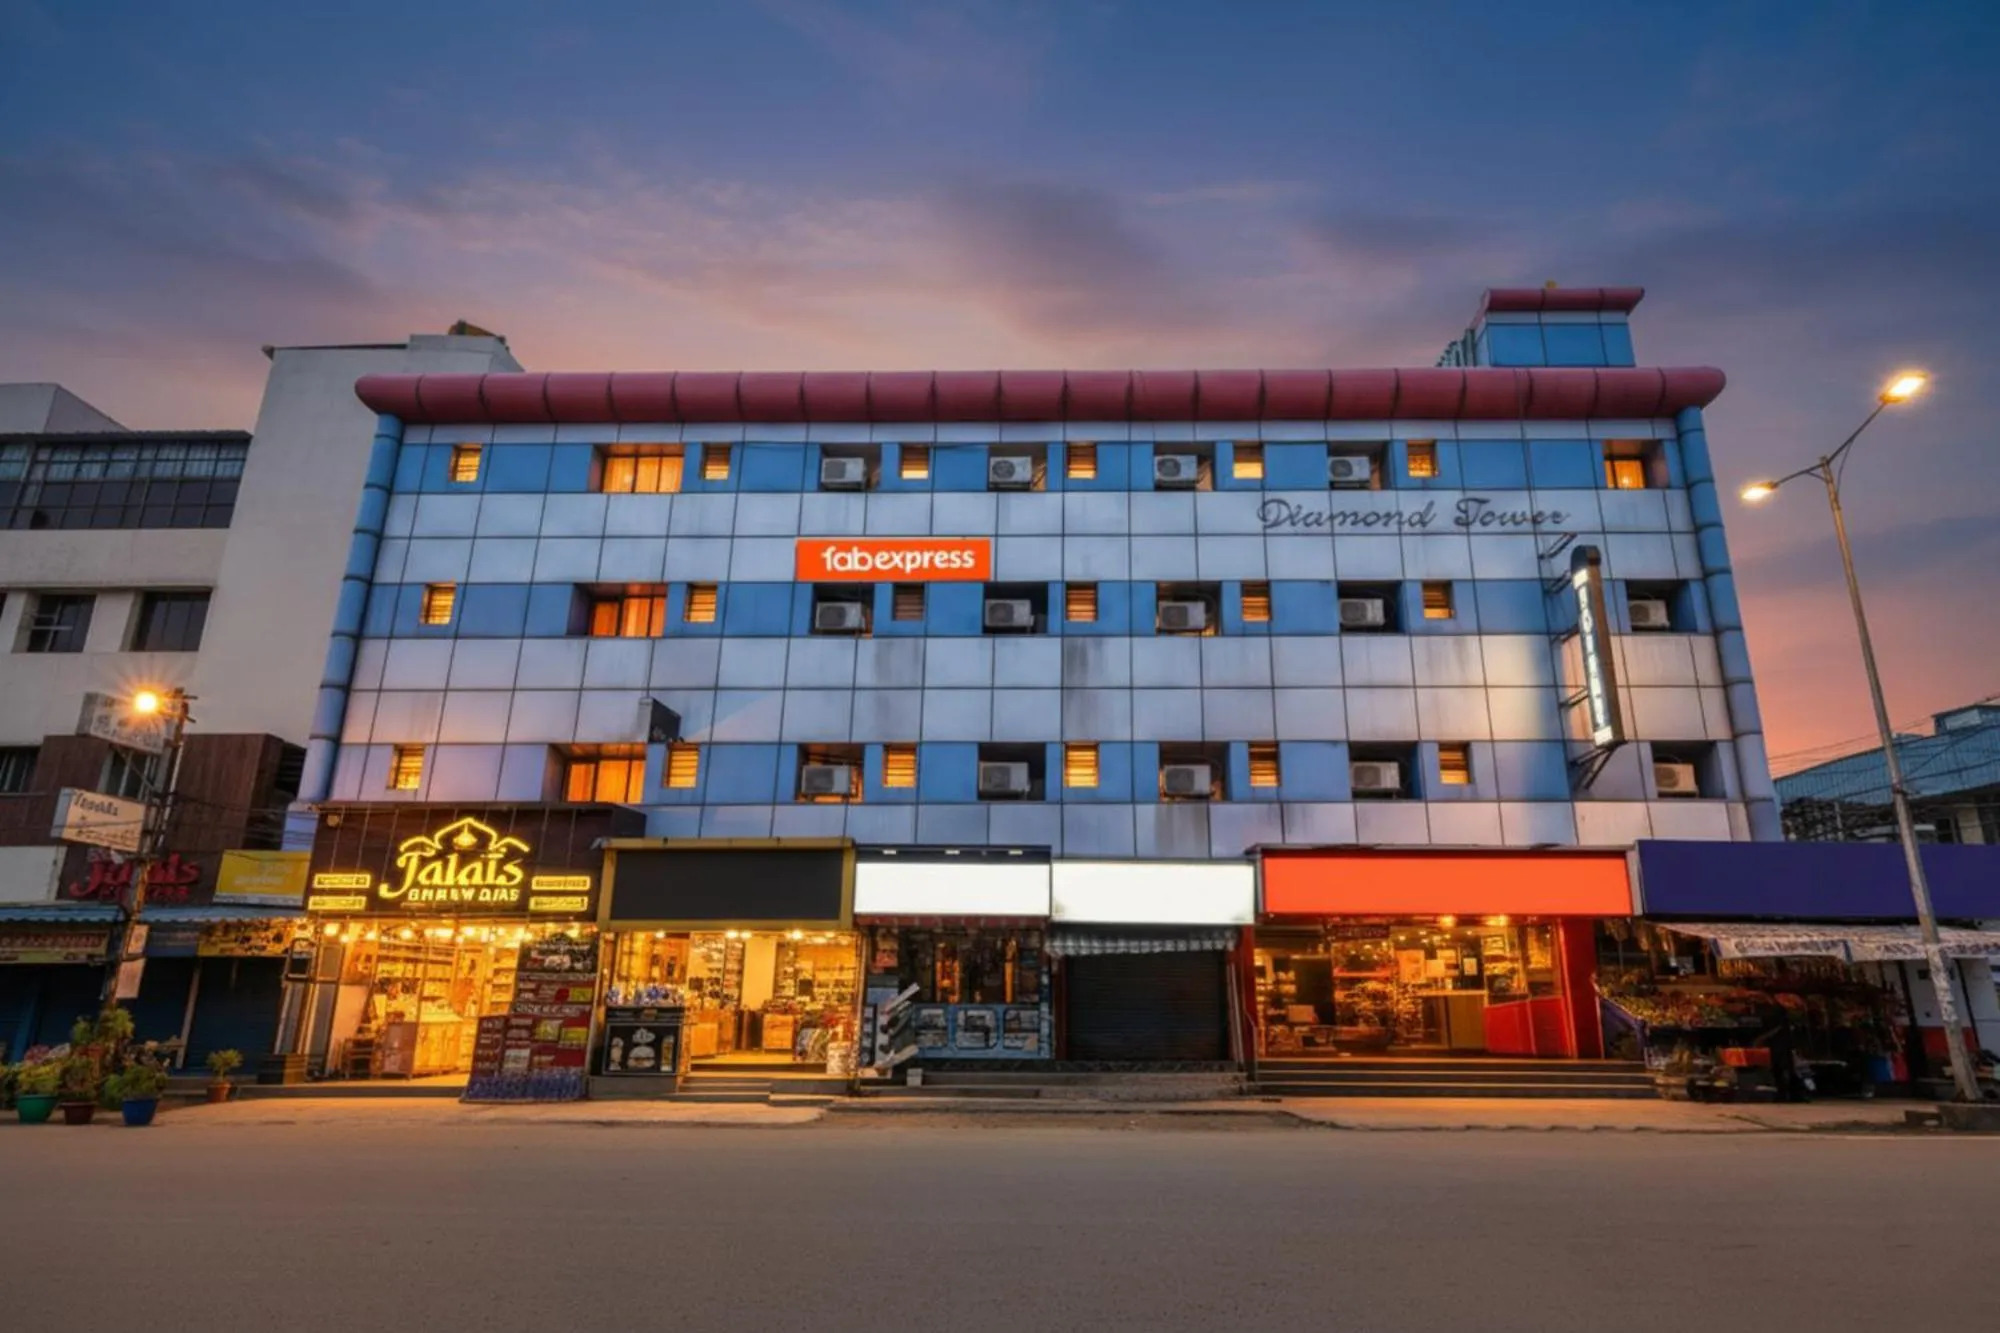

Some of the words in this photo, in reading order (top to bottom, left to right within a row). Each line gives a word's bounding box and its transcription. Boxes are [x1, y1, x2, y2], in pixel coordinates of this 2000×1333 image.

[1257, 498, 1436, 529] Diamond
[1454, 498, 1570, 528] Tower
[822, 546, 975, 574] fabexpress
